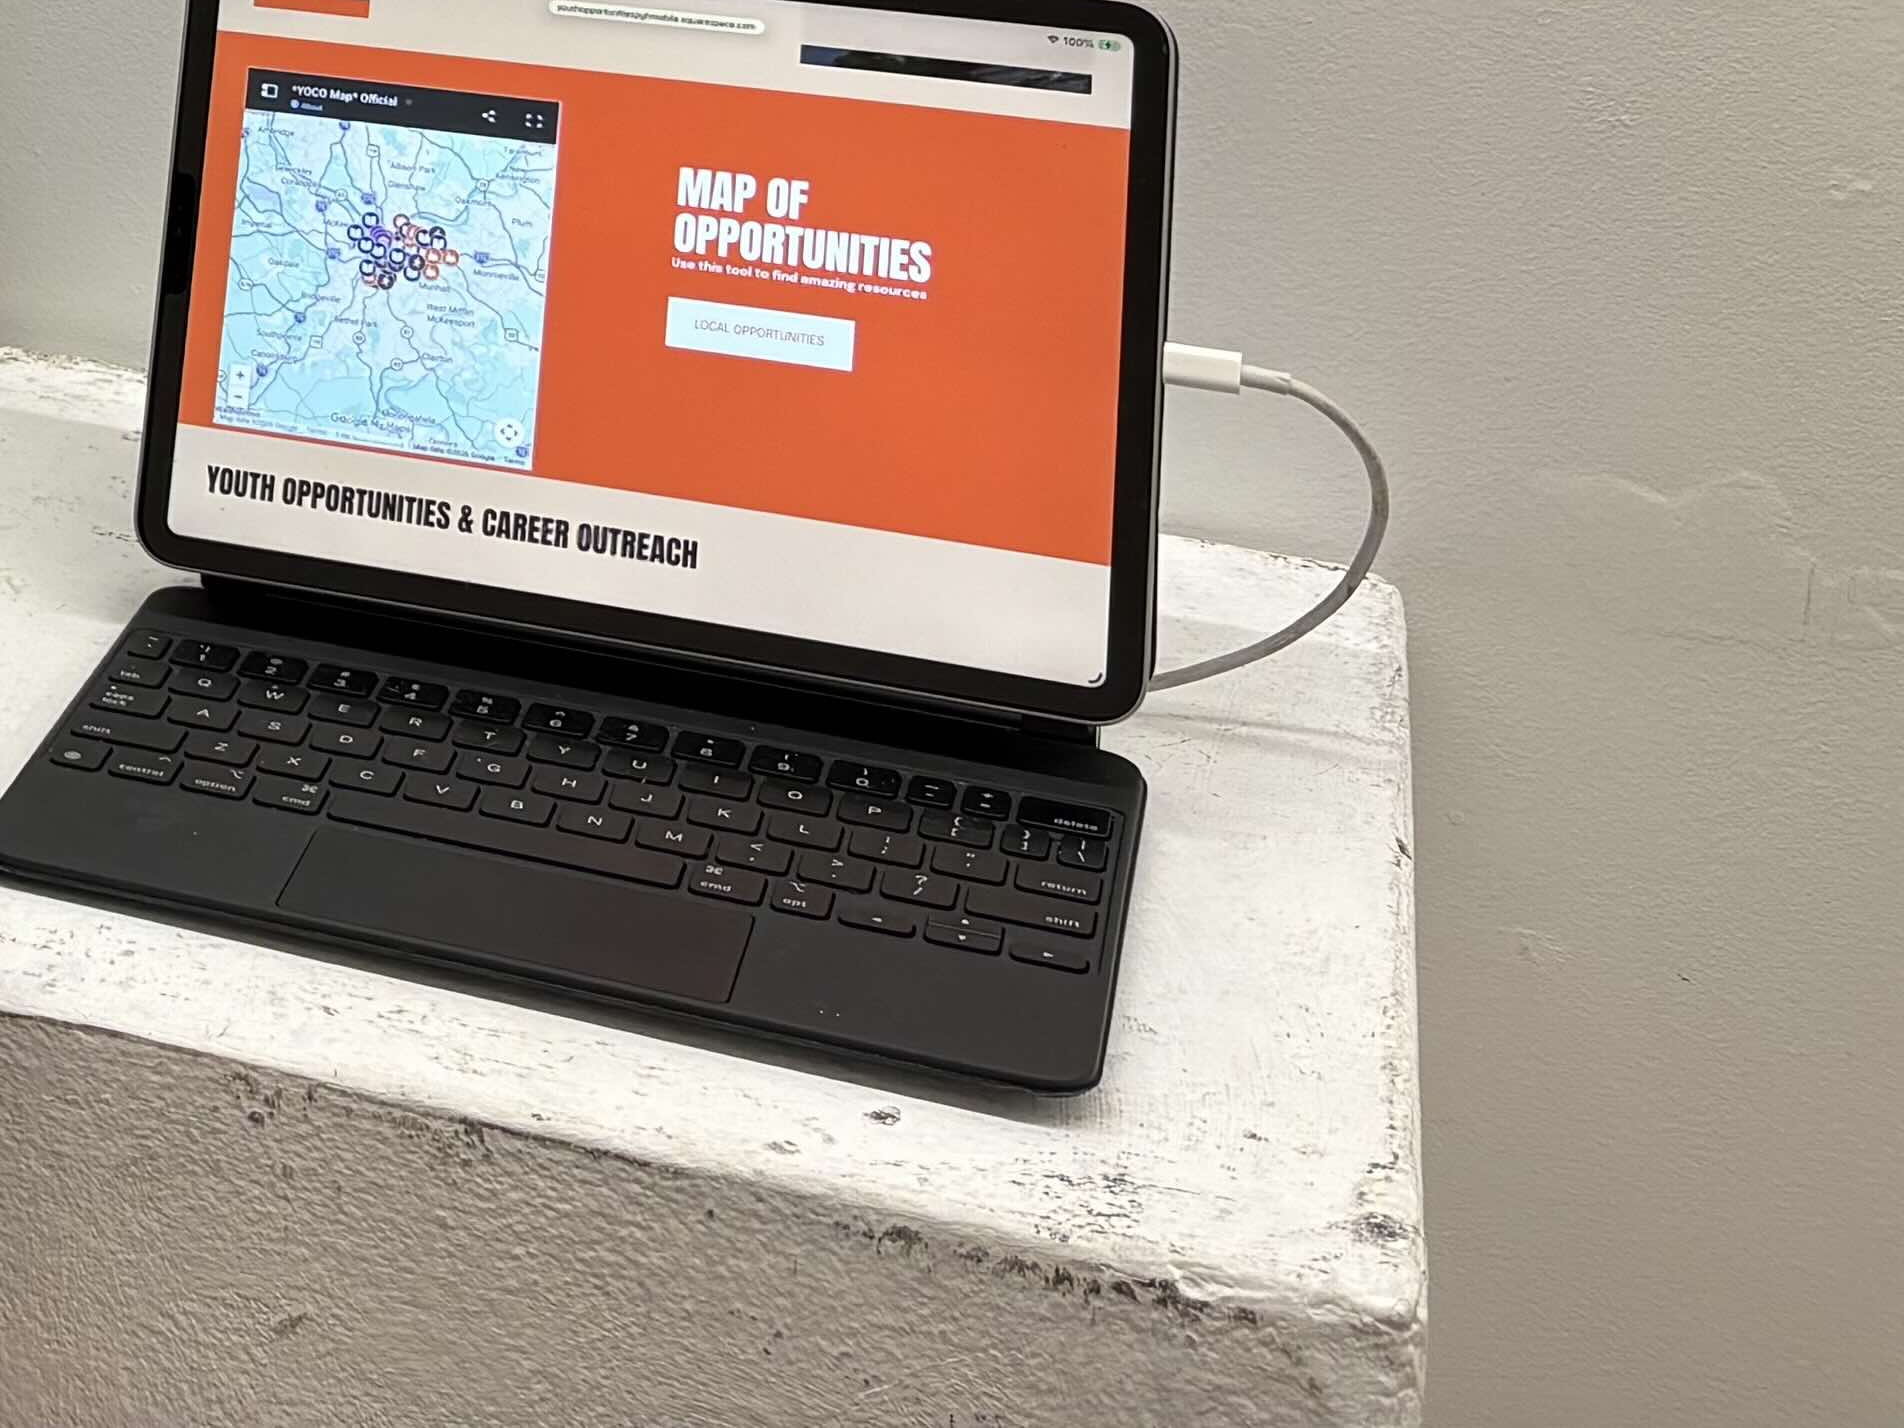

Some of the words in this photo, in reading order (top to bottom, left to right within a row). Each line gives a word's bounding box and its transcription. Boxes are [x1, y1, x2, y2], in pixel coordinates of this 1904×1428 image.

[1063, 36, 1095, 49] 100%
[360, 93, 398, 107] Official
[677, 166, 757, 213] MAP
[765, 177, 809, 220] OF
[673, 212, 932, 283] OPPORTUNITIES
[671, 257, 696, 270] Use
[699, 259, 723, 274] this
[726, 263, 752, 279] tool
[755, 268, 769, 280] to
[772, 269, 799, 284] find
[800, 275, 855, 294] amazing
[857, 283, 927, 300] resources
[694, 319, 730, 334] LOCAL
[733, 324, 825, 347] OPPORTUNITIES
[207, 464, 275, 503] YOUTH
[281, 477, 451, 531] OPPORTUNITIES
[458, 505, 474, 534] &
[481, 507, 569, 549] CAREER
[576, 522, 698, 570] OUTREACH
[194, 779, 236, 794] option
[1041, 880, 1087, 896] return
